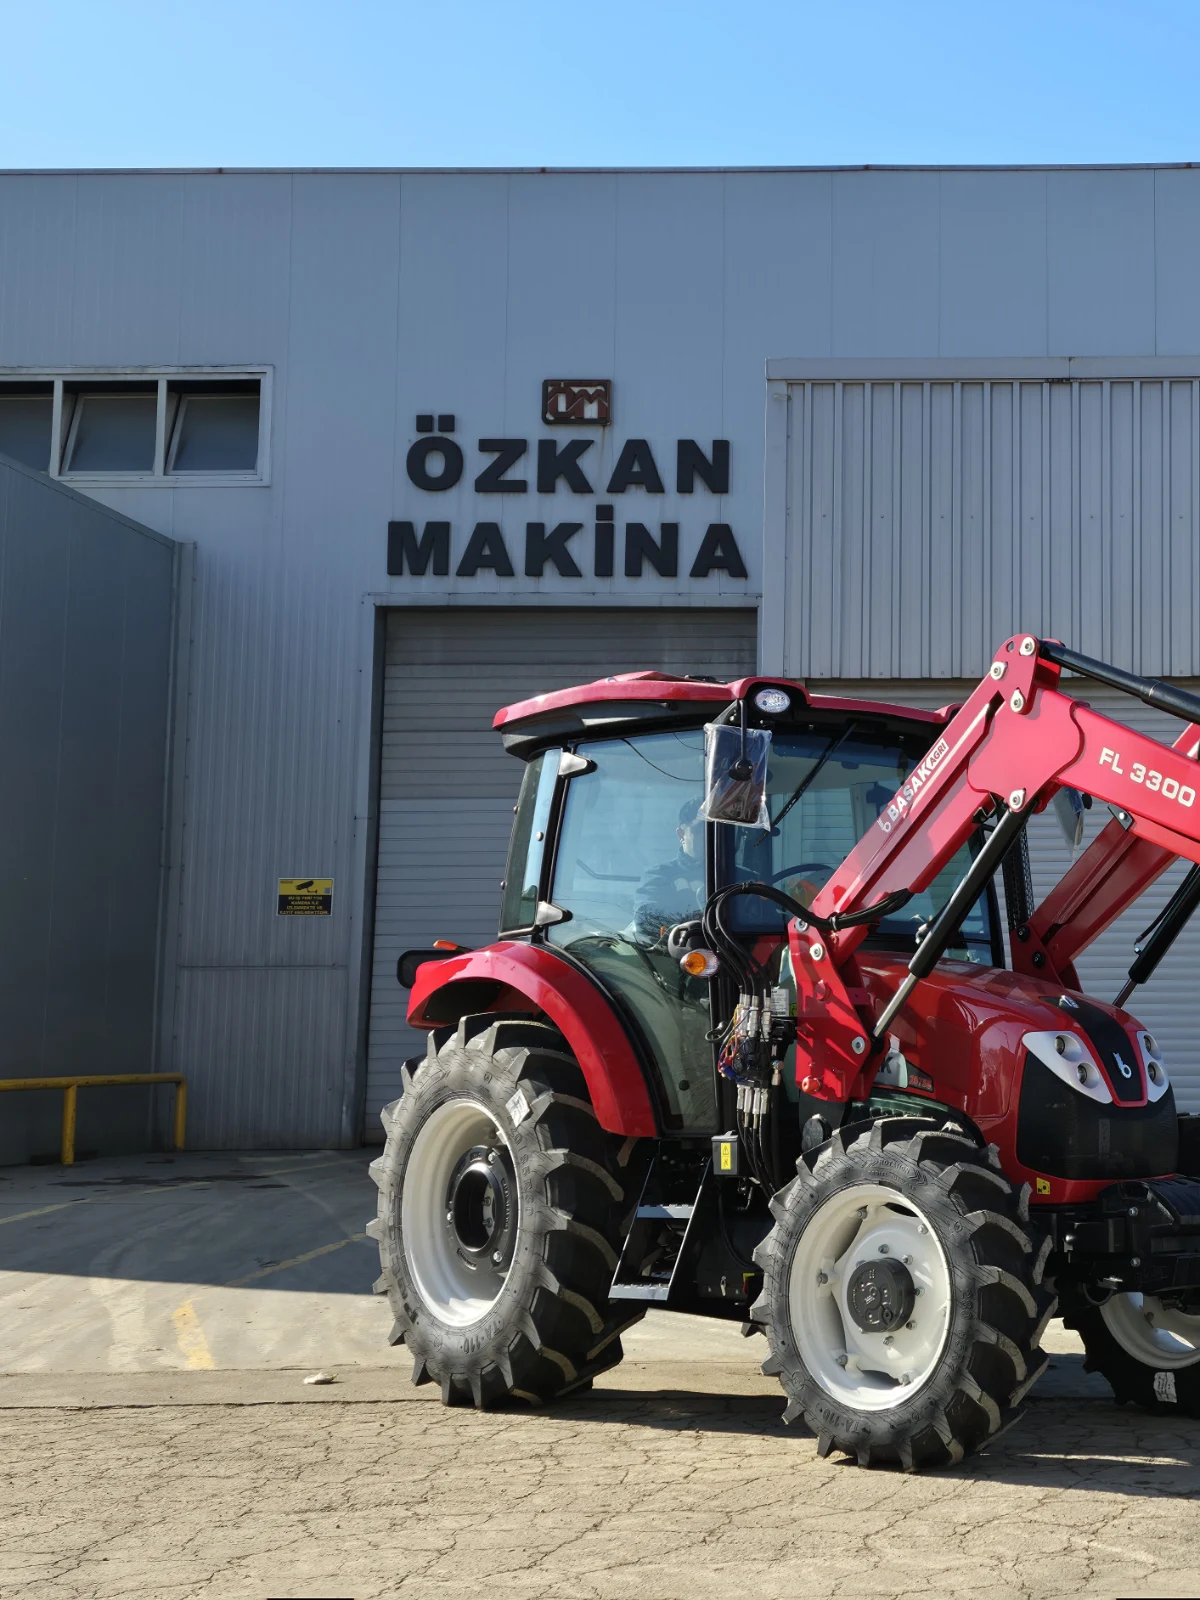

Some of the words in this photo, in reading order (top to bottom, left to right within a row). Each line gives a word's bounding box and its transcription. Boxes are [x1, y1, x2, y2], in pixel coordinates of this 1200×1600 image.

[406, 414, 730, 493] ÖZKAN
[387, 504, 748, 578] MAKİNA
[930, 742, 947, 766] AGRI
[1098, 747, 1123, 775] FL
[1129, 762, 1196, 808] 3300
